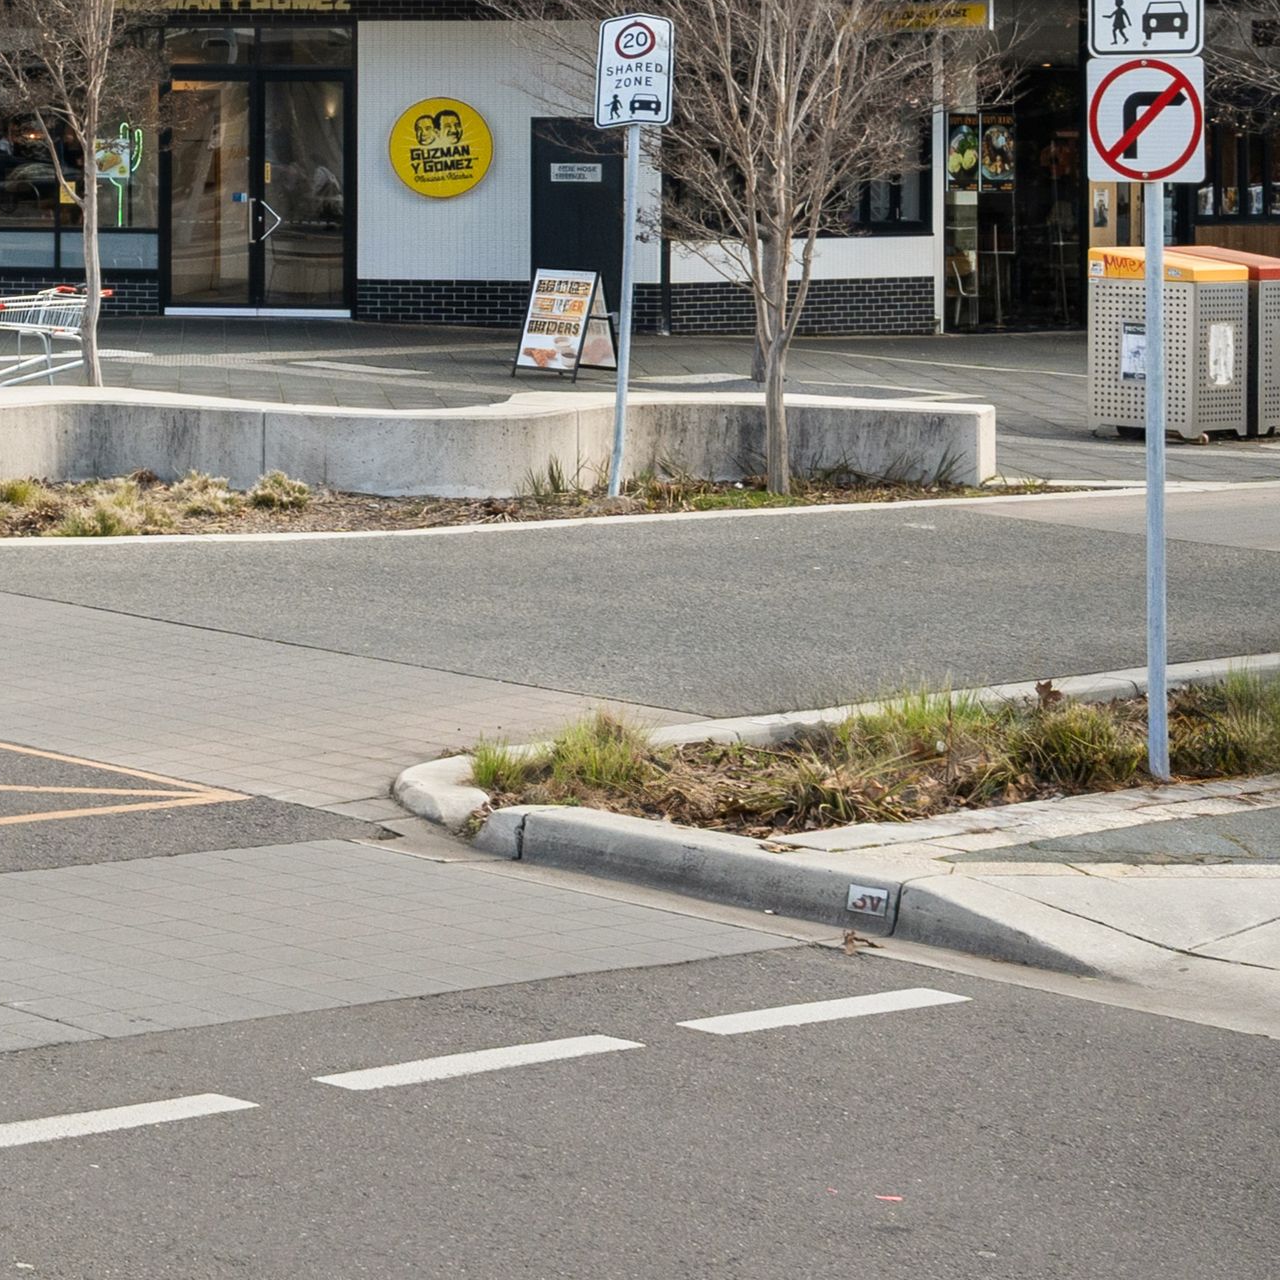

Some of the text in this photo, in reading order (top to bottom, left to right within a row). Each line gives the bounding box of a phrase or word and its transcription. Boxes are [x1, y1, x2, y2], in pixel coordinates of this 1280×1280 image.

[623, 31, 648, 49] 20
[606, 62, 663, 77] SHARED
[615, 76, 653, 89] ZONE
[410, 145, 470, 160] GUZMAN
[411, 158, 473, 174] Y GOMEZ
